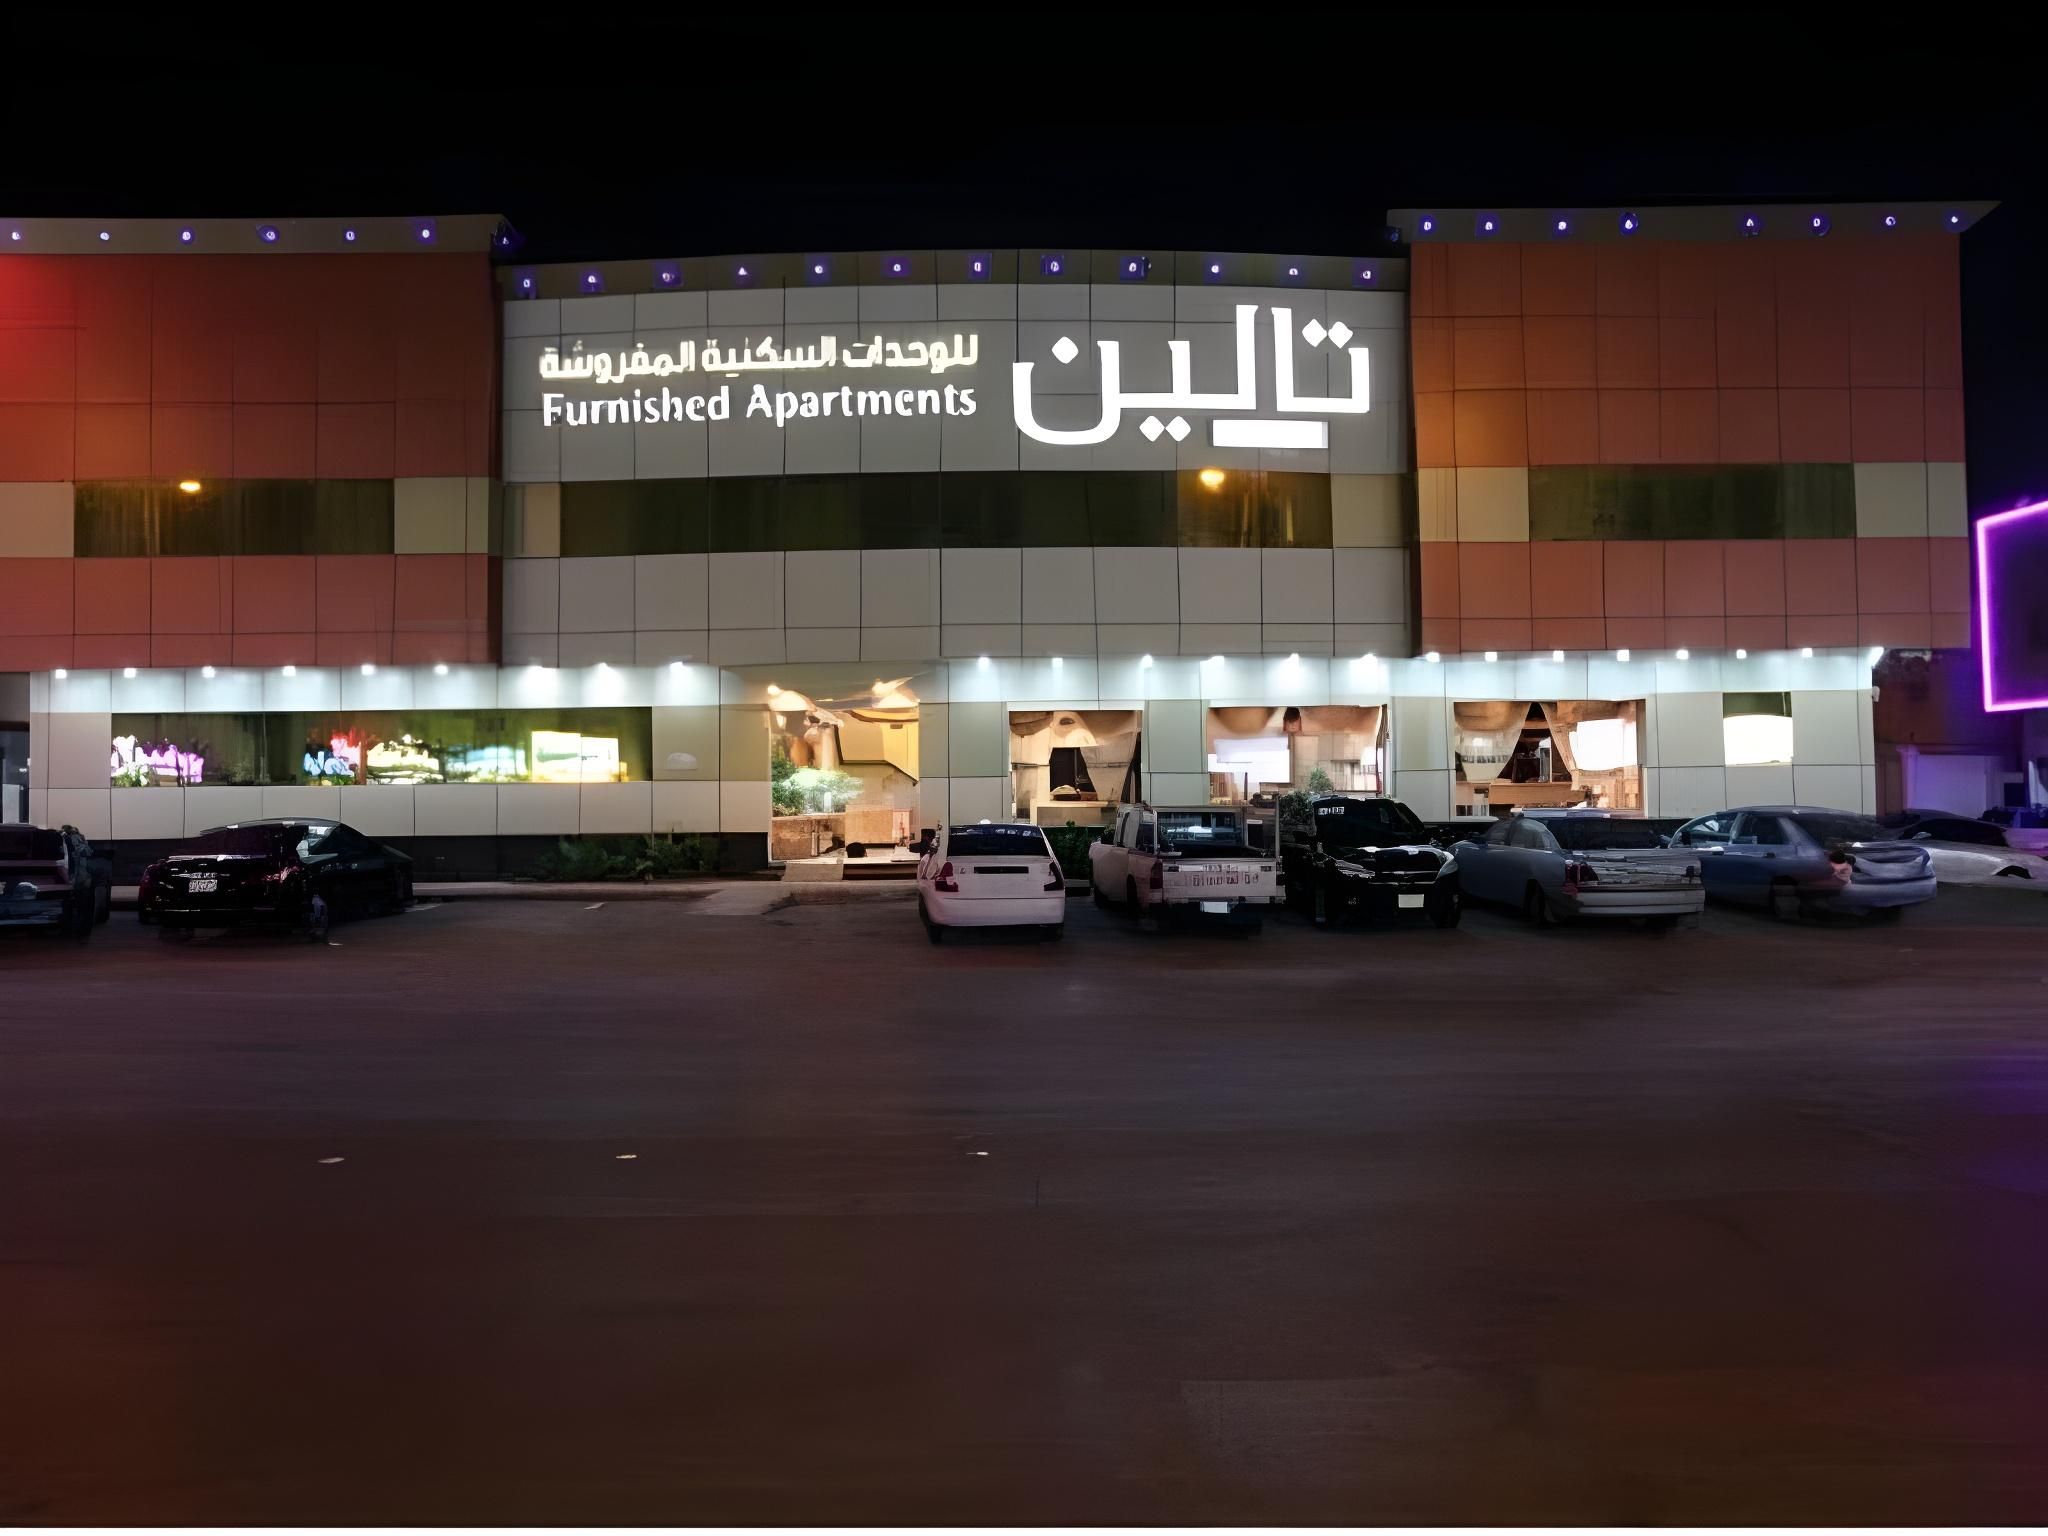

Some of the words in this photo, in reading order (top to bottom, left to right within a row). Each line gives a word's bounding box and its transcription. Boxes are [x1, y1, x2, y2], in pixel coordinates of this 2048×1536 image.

[539, 340, 696, 384] المفروشة
[701, 335, 837, 378] السكنية
[842, 333, 979, 374] للوحدات
[1012, 304, 1370, 446] تالين
[542, 385, 729, 427] Furnished
[746, 383, 977, 427] Apartments
